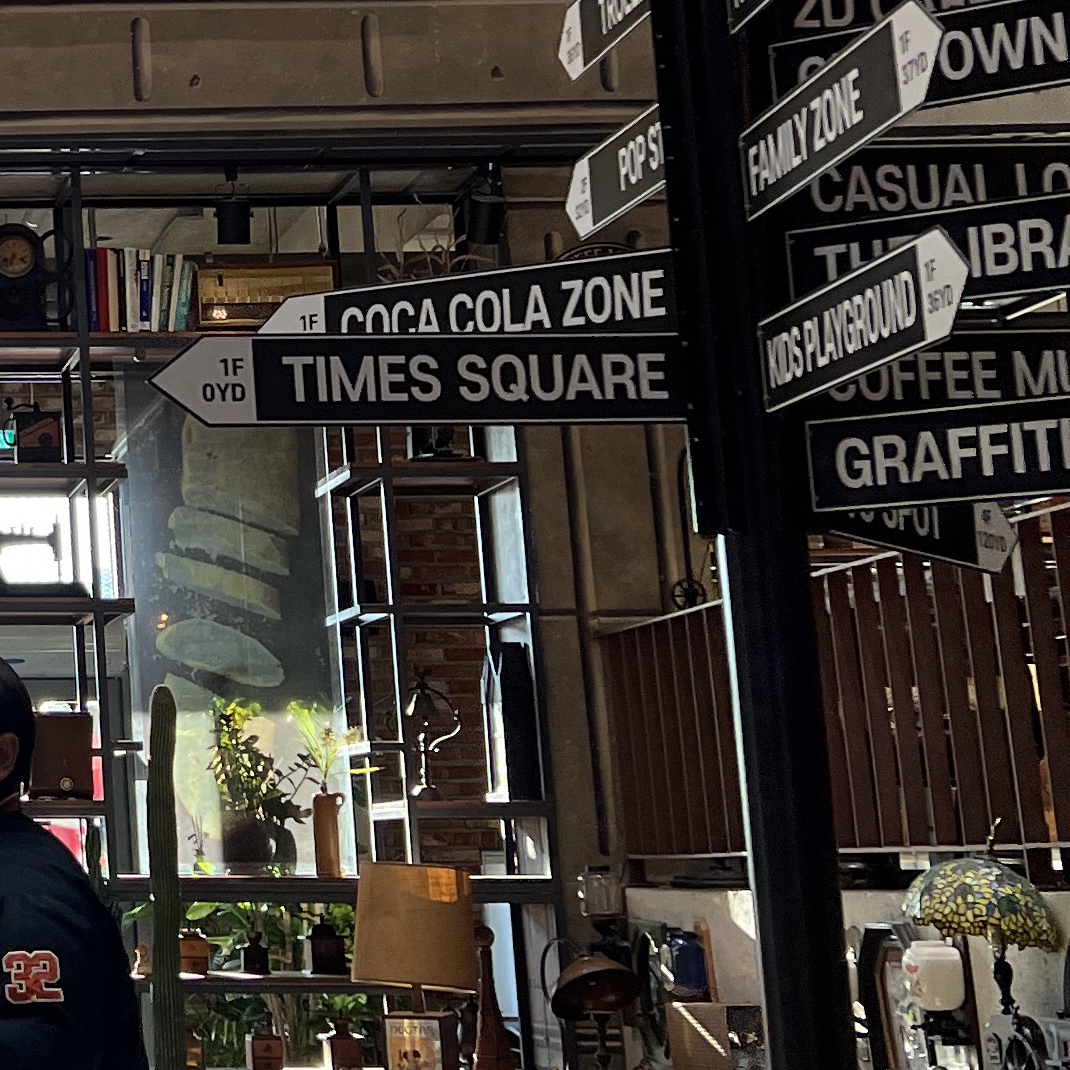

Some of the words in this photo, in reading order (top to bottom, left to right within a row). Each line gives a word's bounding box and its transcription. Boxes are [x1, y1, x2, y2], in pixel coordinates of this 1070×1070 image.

[748, 106, 808, 197] FAMILY
[809, 67, 864, 152] ZONE
[618, 134, 647, 191] POP
[299, 313, 318, 331] 1F
[341, 299, 440, 333] COCA
[449, 285, 550, 333] COLA
[561, 269, 667, 327] ZONE
[766, 325, 805, 390] KIDS
[803, 270, 917, 373] PLAYGROUND
[218, 357, 244, 377] 1F
[282, 353, 441, 403] TIMES
[457, 351, 669, 404] SQUARE
[828, 350, 1002, 402] OFFEE
[835, 417, 1070, 489] GRAFFITI
[2, 950, 65, 1005] 32
